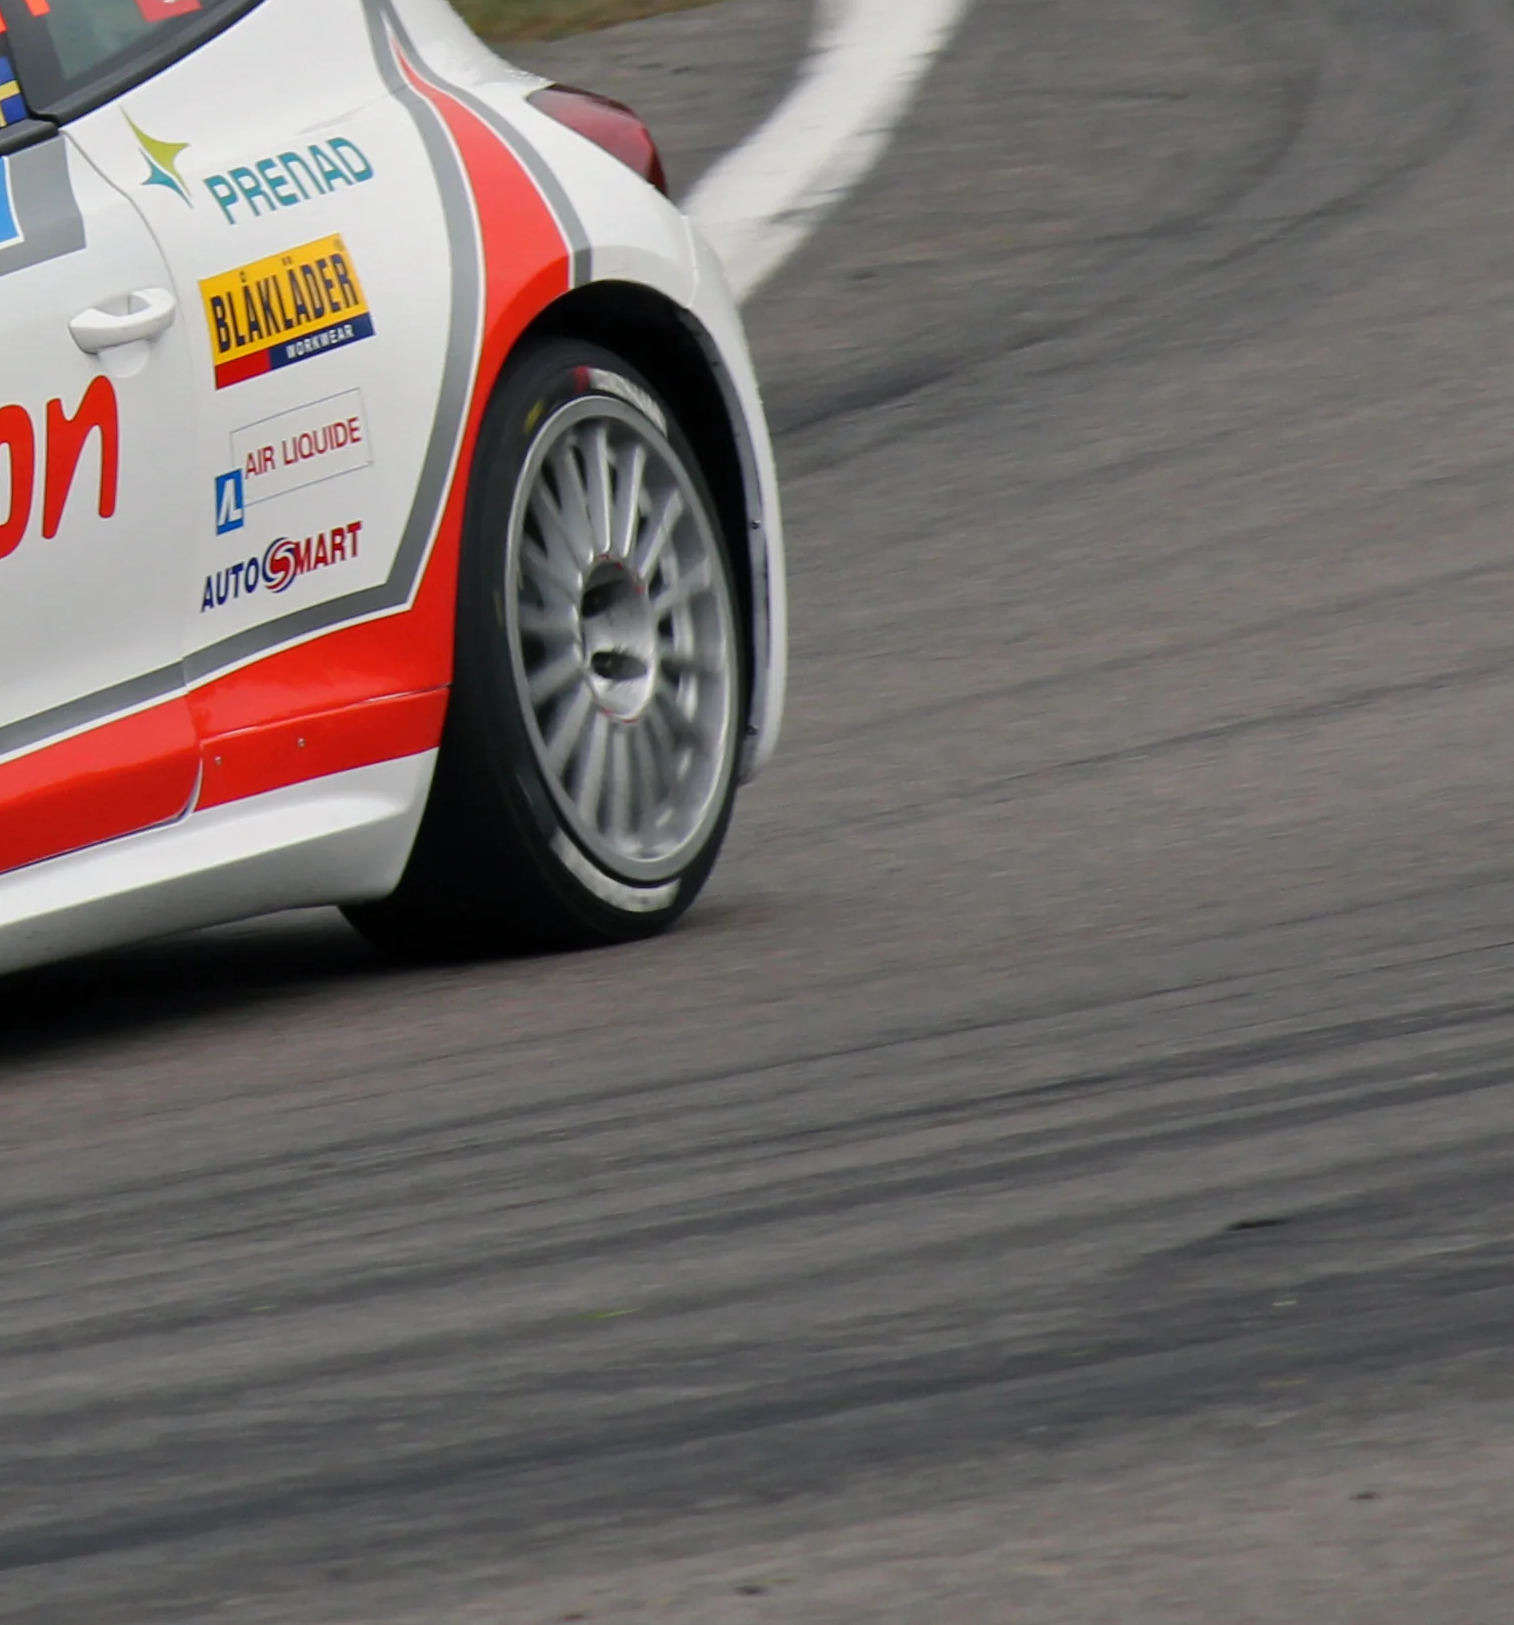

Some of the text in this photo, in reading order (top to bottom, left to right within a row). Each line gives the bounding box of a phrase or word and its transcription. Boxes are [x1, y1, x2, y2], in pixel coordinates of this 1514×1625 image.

[210, 255, 360, 354] BLÅKLÄDER
[285, 324, 354, 359] WORKWEAR
[245, 417, 362, 479] AIR LIQUIDE
